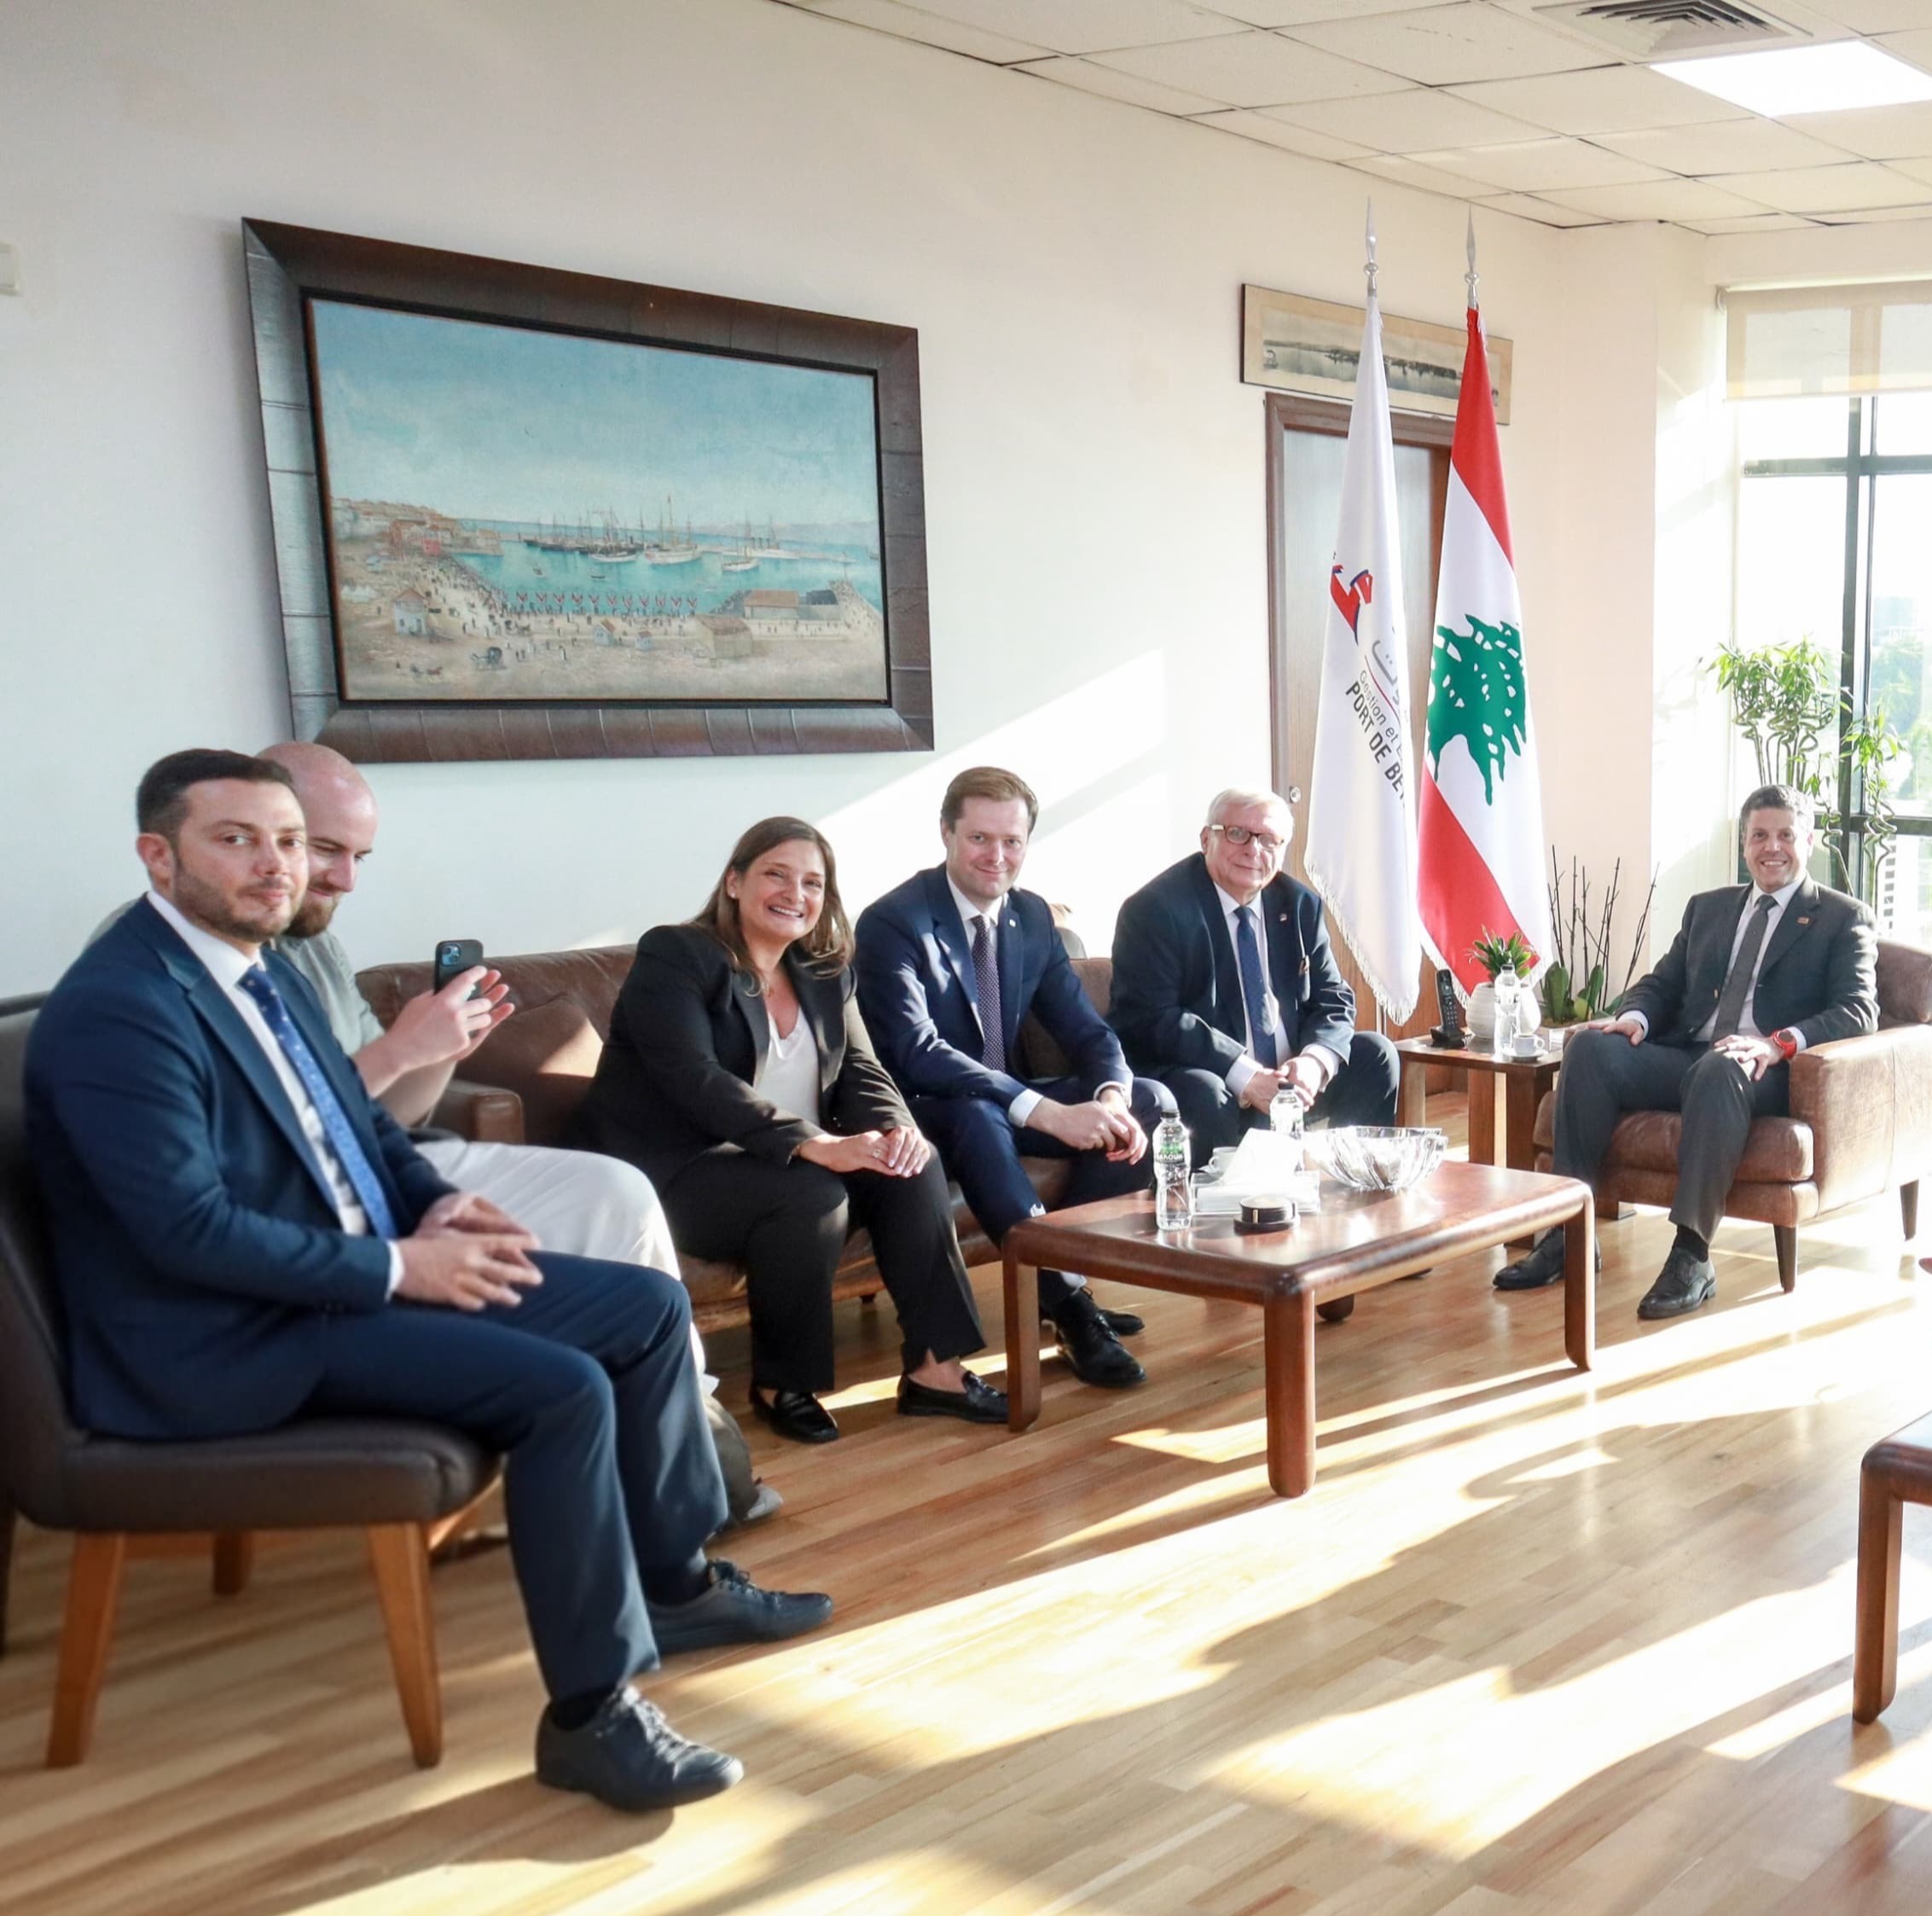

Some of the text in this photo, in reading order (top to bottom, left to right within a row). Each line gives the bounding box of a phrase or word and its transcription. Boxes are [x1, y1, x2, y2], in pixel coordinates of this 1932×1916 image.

[1345, 681, 1374, 733] PORT
[1369, 731, 1392, 763] DE
[1384, 762, 1404, 800] BE
[1360, 670, 1387, 725] Gestion
[1385, 727, 1399, 743] et
